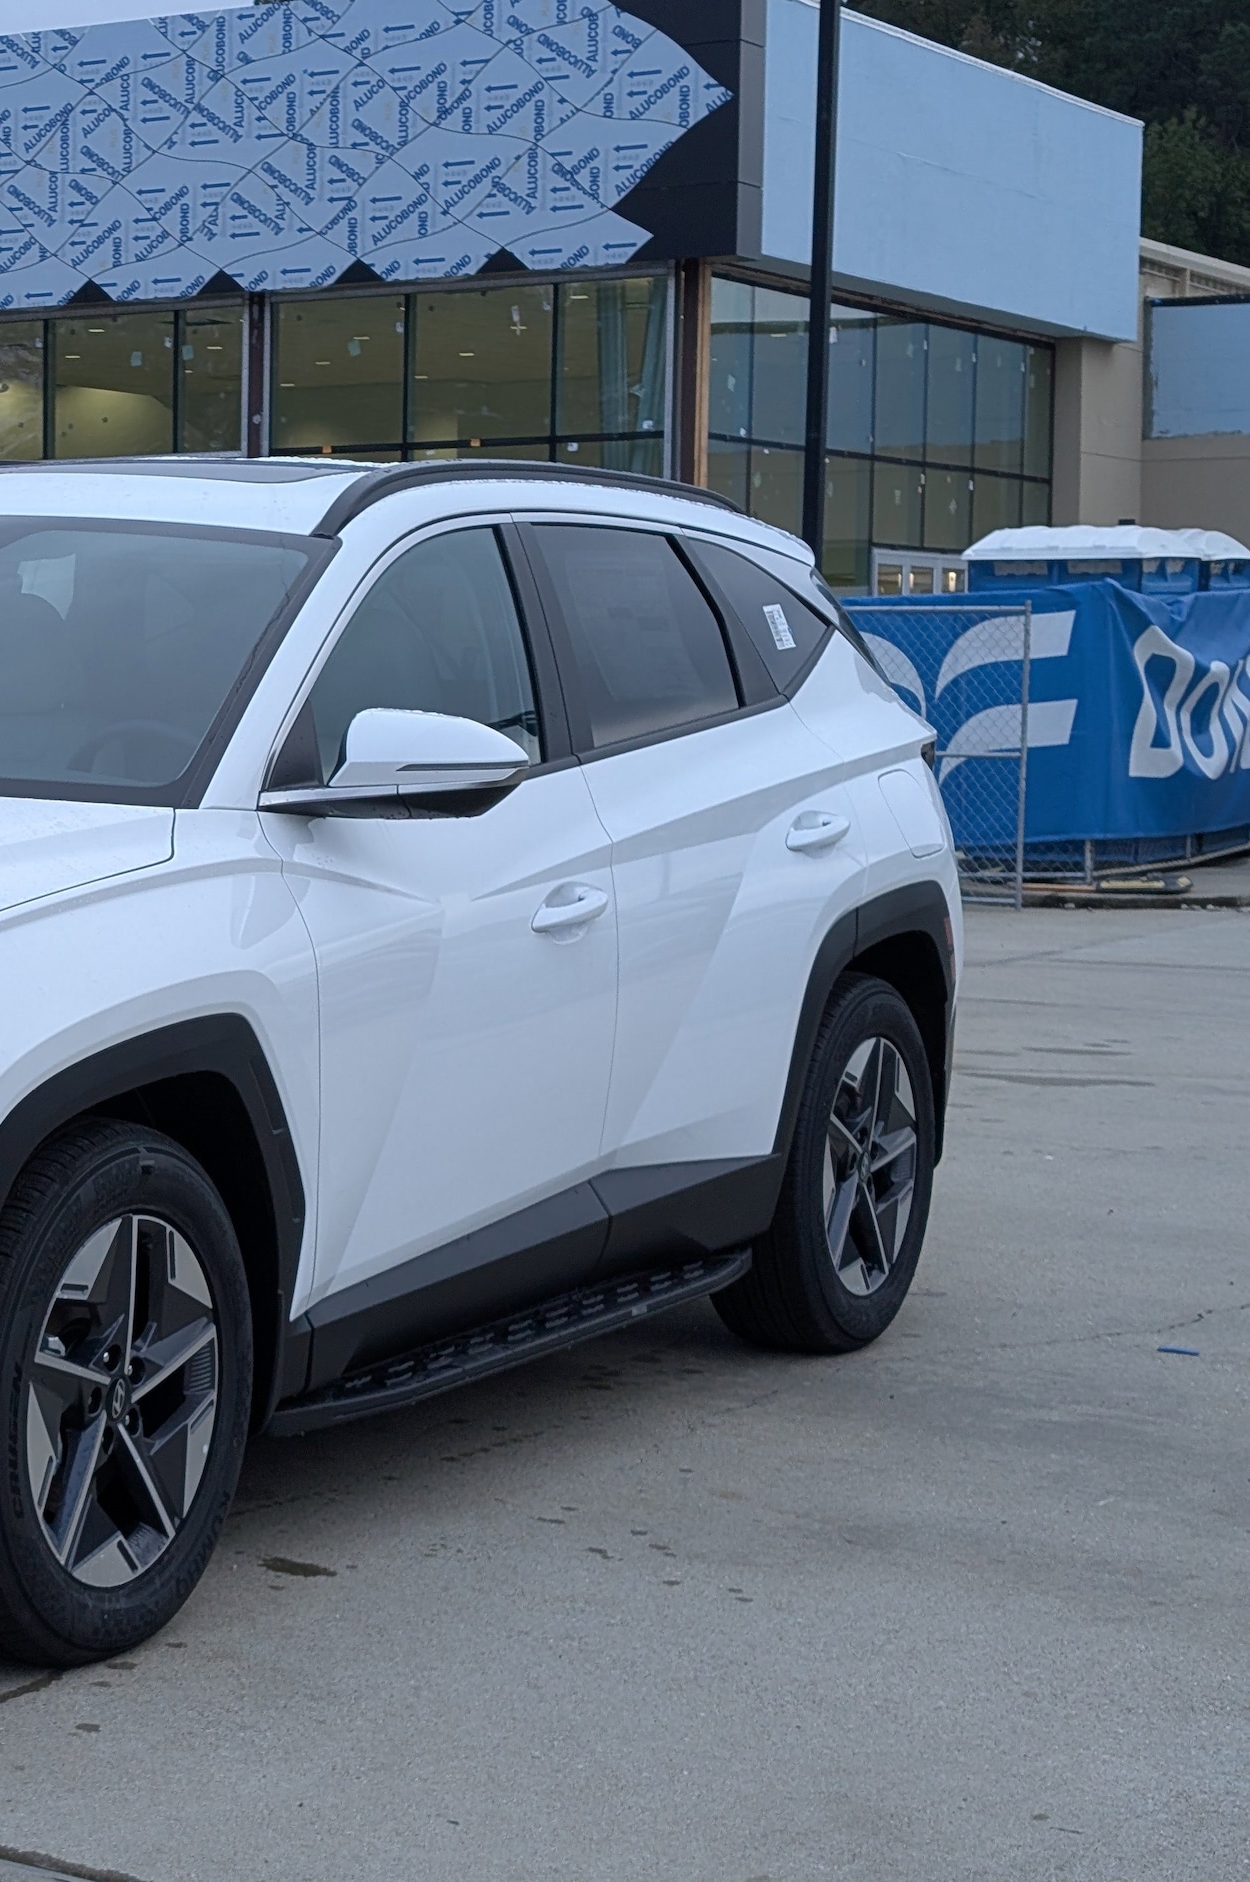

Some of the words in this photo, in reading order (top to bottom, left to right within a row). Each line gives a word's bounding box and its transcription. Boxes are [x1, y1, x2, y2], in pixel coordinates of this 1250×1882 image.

[238, 1, 286, 44] ALUCOBO
[537, 33, 598, 79] ALUCOBOND
[141, 77, 191, 118] LUCOBOND
[258, 73, 296, 111] COBOND
[352, 79, 385, 111] ALUCO
[486, 80, 545, 134] ALUCOBOND
[628, 65, 690, 120] ALUCOBOND
[23, 103, 74, 153] ALUCOBOND
[82, 108, 111, 138] ALUCO
[7, 184, 57, 228] ALUCOBOND
[261, 161, 315, 206] ALUCOBOND
[443, 156, 502, 211] ALUCOBOND
[230, 192, 285, 236] ALUCOBOND
[371, 193, 429, 246] ALUCOBOND
[70, 219, 122, 268] ALUCOBOND
